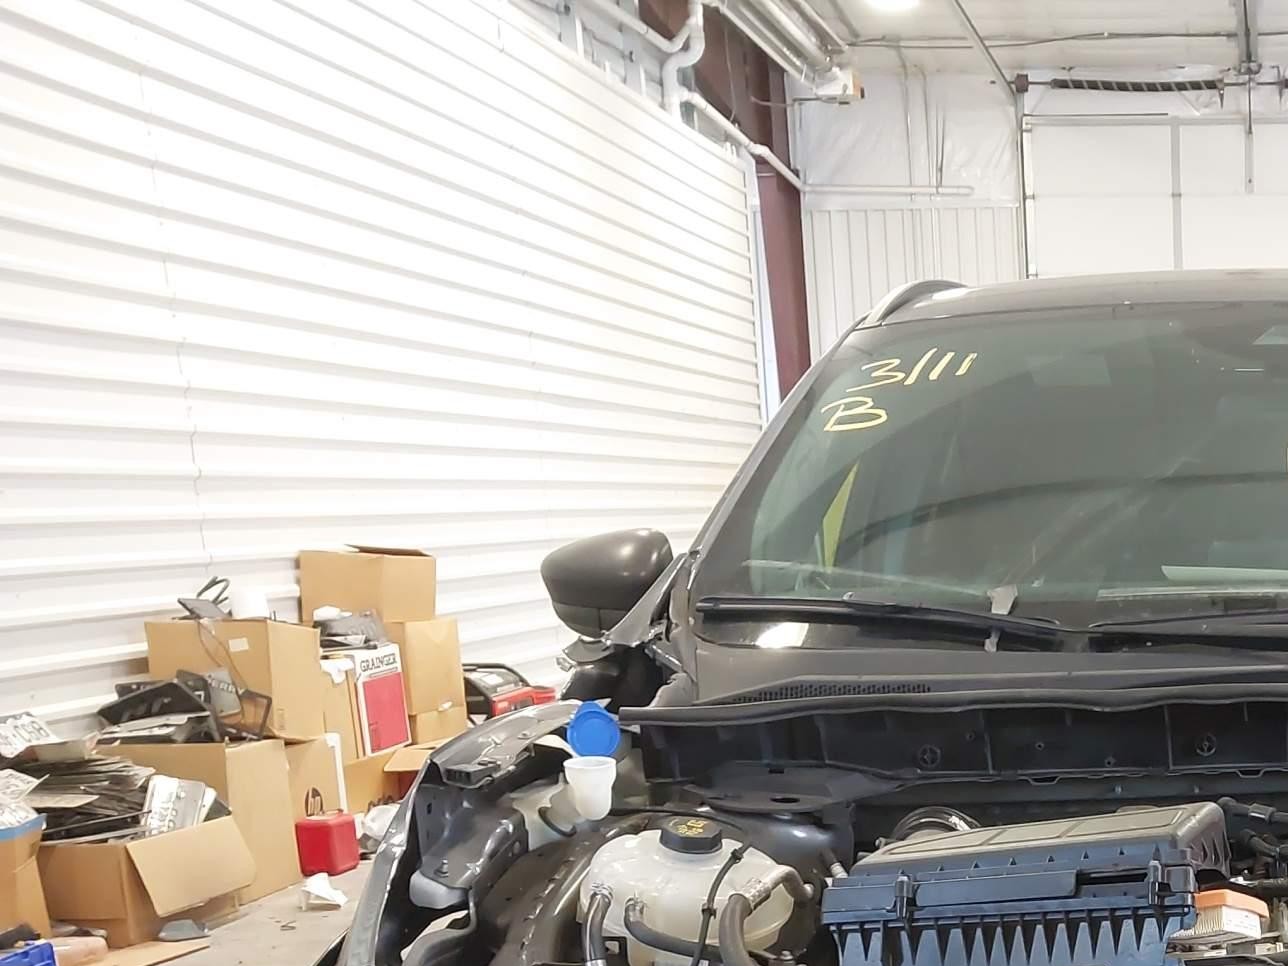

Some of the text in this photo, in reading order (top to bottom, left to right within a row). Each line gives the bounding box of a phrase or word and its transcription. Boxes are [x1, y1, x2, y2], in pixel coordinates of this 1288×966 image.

[846, 347, 978, 393] 3/11
[820, 396, 888, 432] B
[360, 653, 398, 672] GRAINGER
